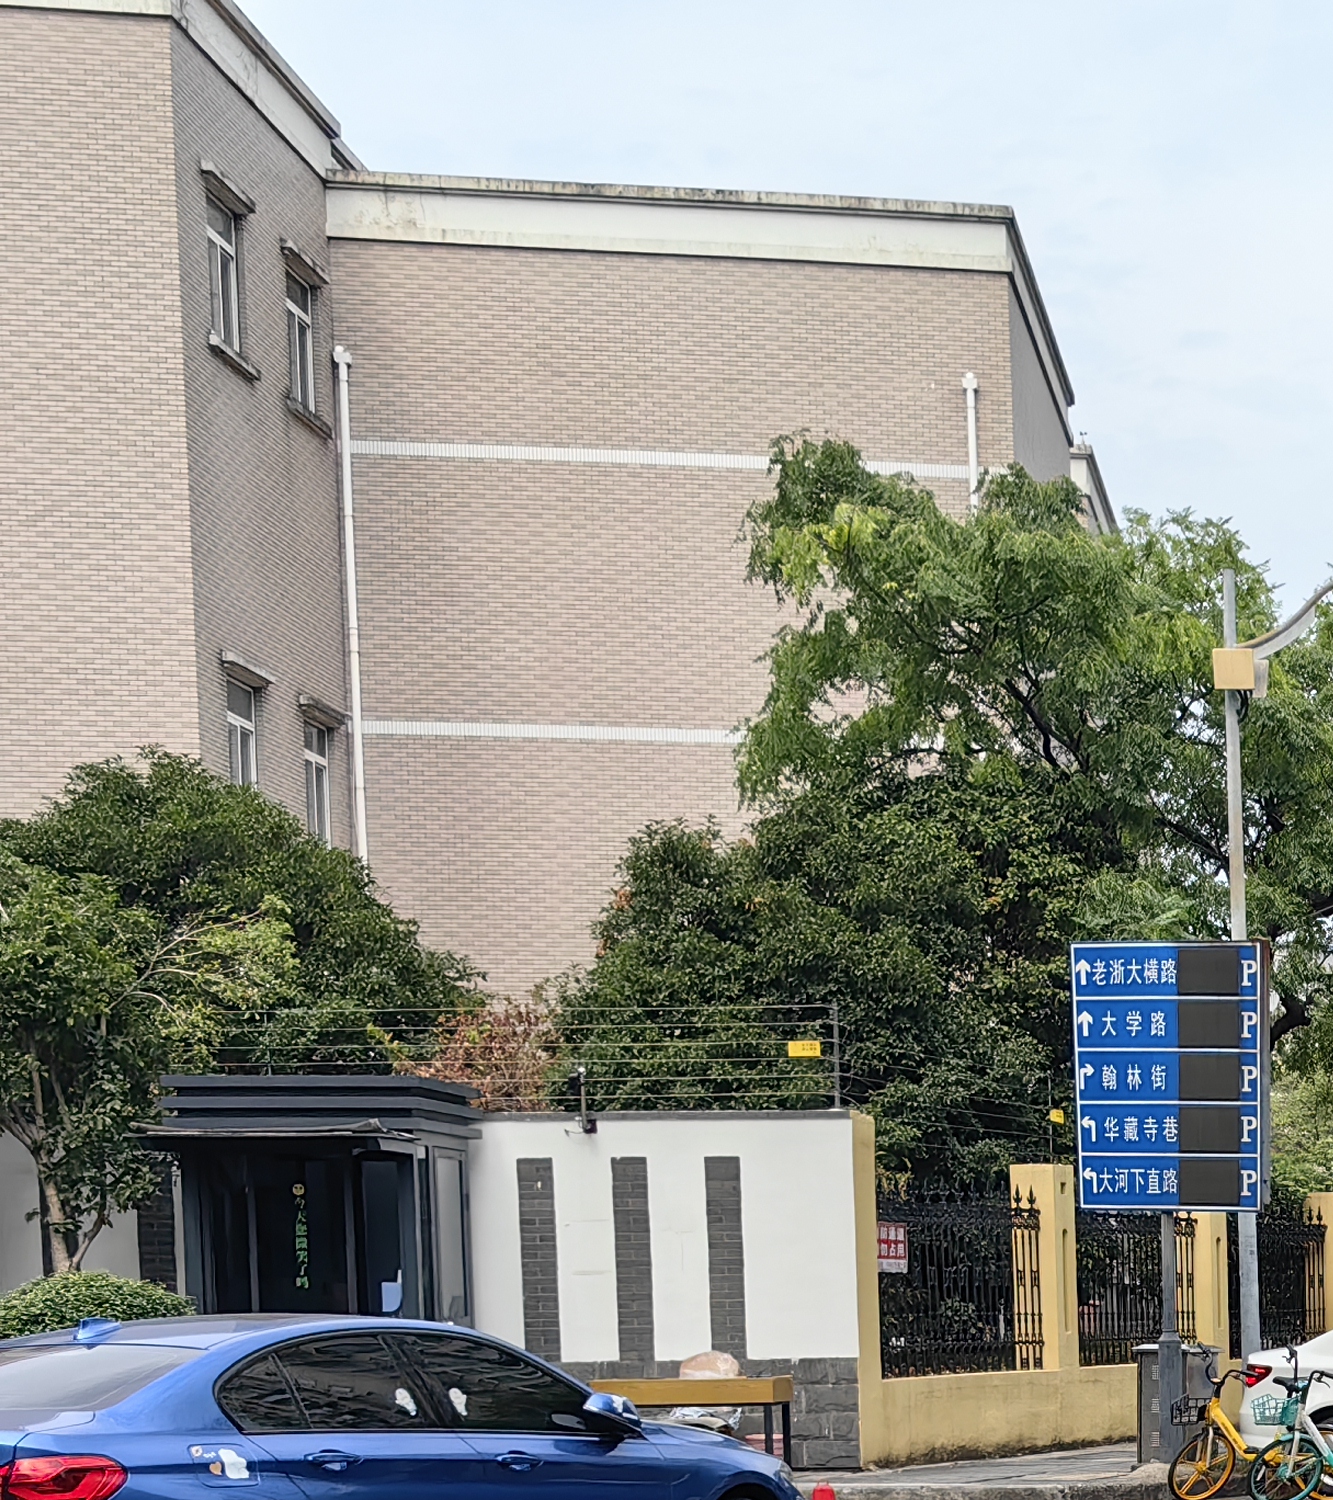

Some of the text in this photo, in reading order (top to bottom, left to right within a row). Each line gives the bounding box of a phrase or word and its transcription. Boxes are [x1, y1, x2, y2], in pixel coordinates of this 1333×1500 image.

[1091, 958, 1178, 986] 老浙大横路
[1240, 959, 1258, 986] P
[1101, 1010, 1166, 1038] 大学路
[1240, 1011, 1258, 1038] P
[1101, 1064, 1167, 1092] 翰林街
[1240, 1065, 1258, 1092] P
[1103, 1116, 1179, 1143] 华藏寺巷
[1240, 1115, 1258, 1142] P
[1098, 1167, 1178, 1195] 大河下直路
[1240, 1169, 1257, 1196] P
